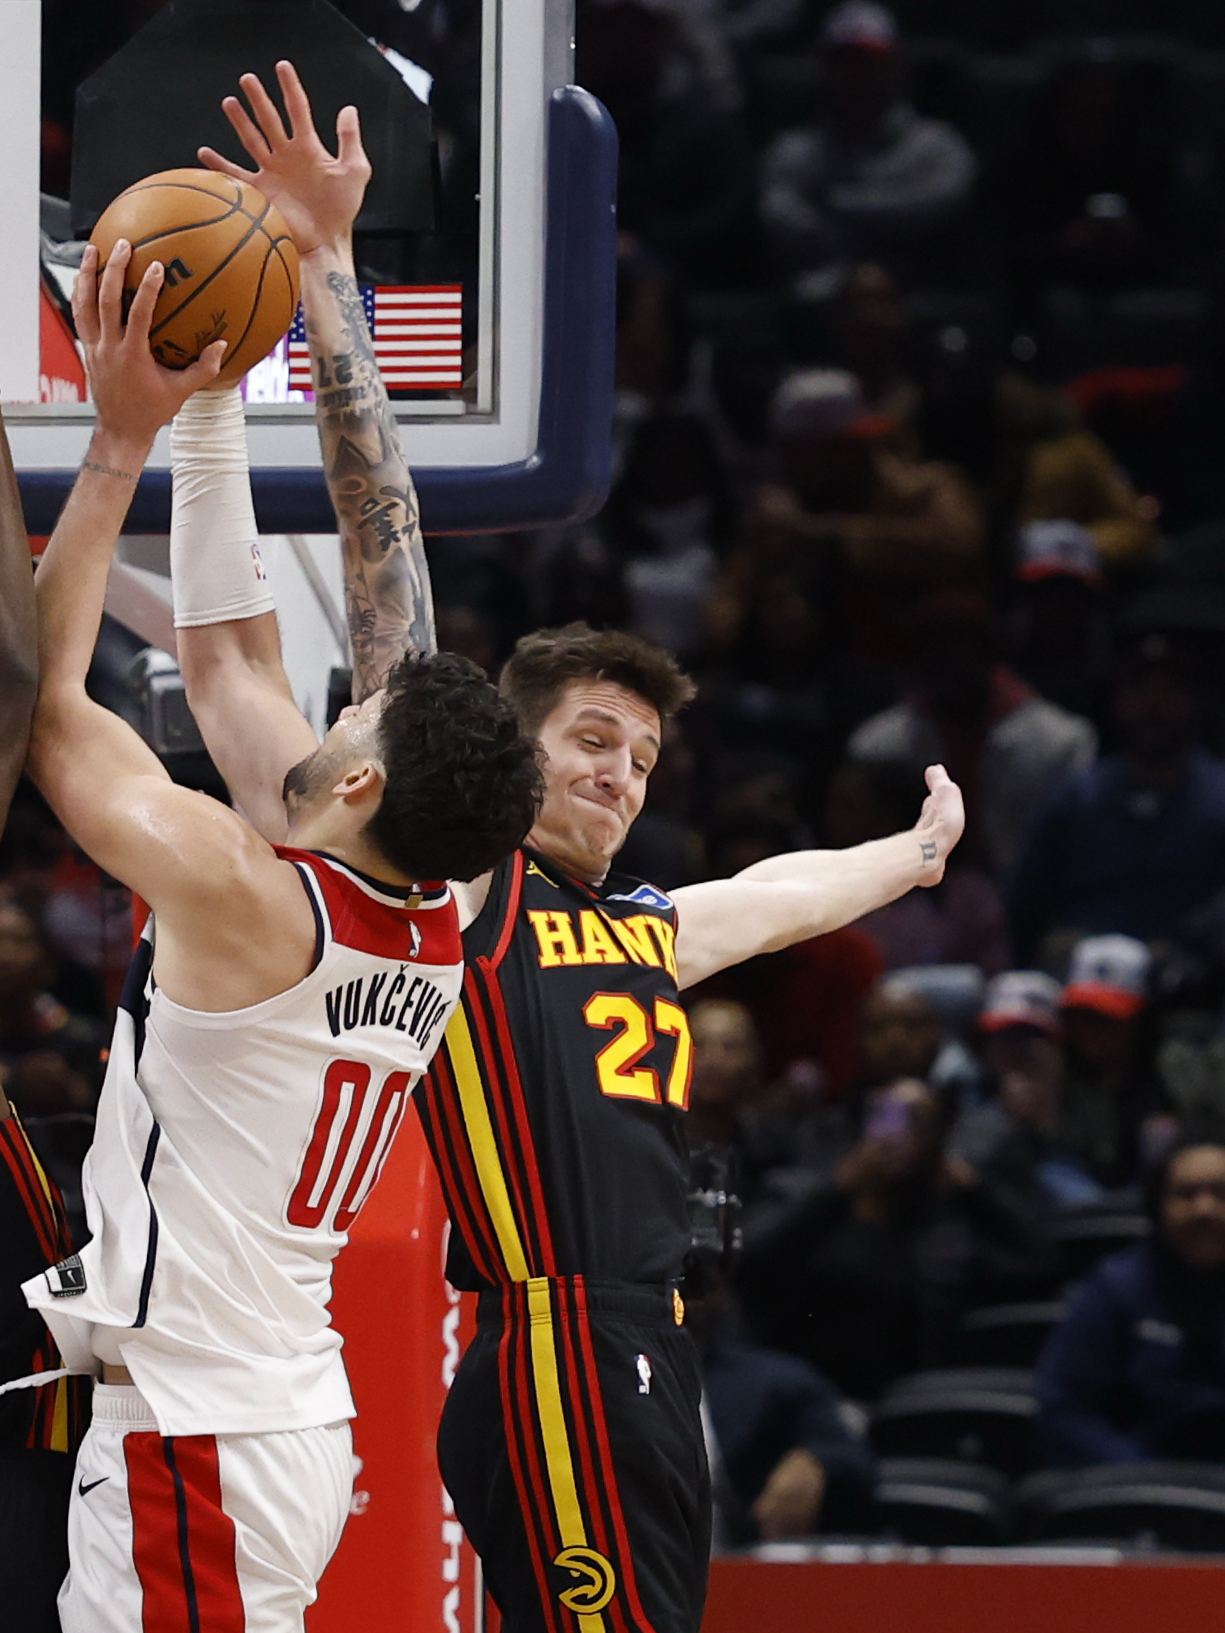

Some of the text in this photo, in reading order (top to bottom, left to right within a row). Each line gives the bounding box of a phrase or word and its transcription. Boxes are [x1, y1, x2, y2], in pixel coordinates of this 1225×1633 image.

[526, 909, 679, 984] HAWK
[325, 964, 452, 1051] VUKČEVIĆ
[582, 991, 696, 1112] 27
[287, 1059, 412, 1232] 00
